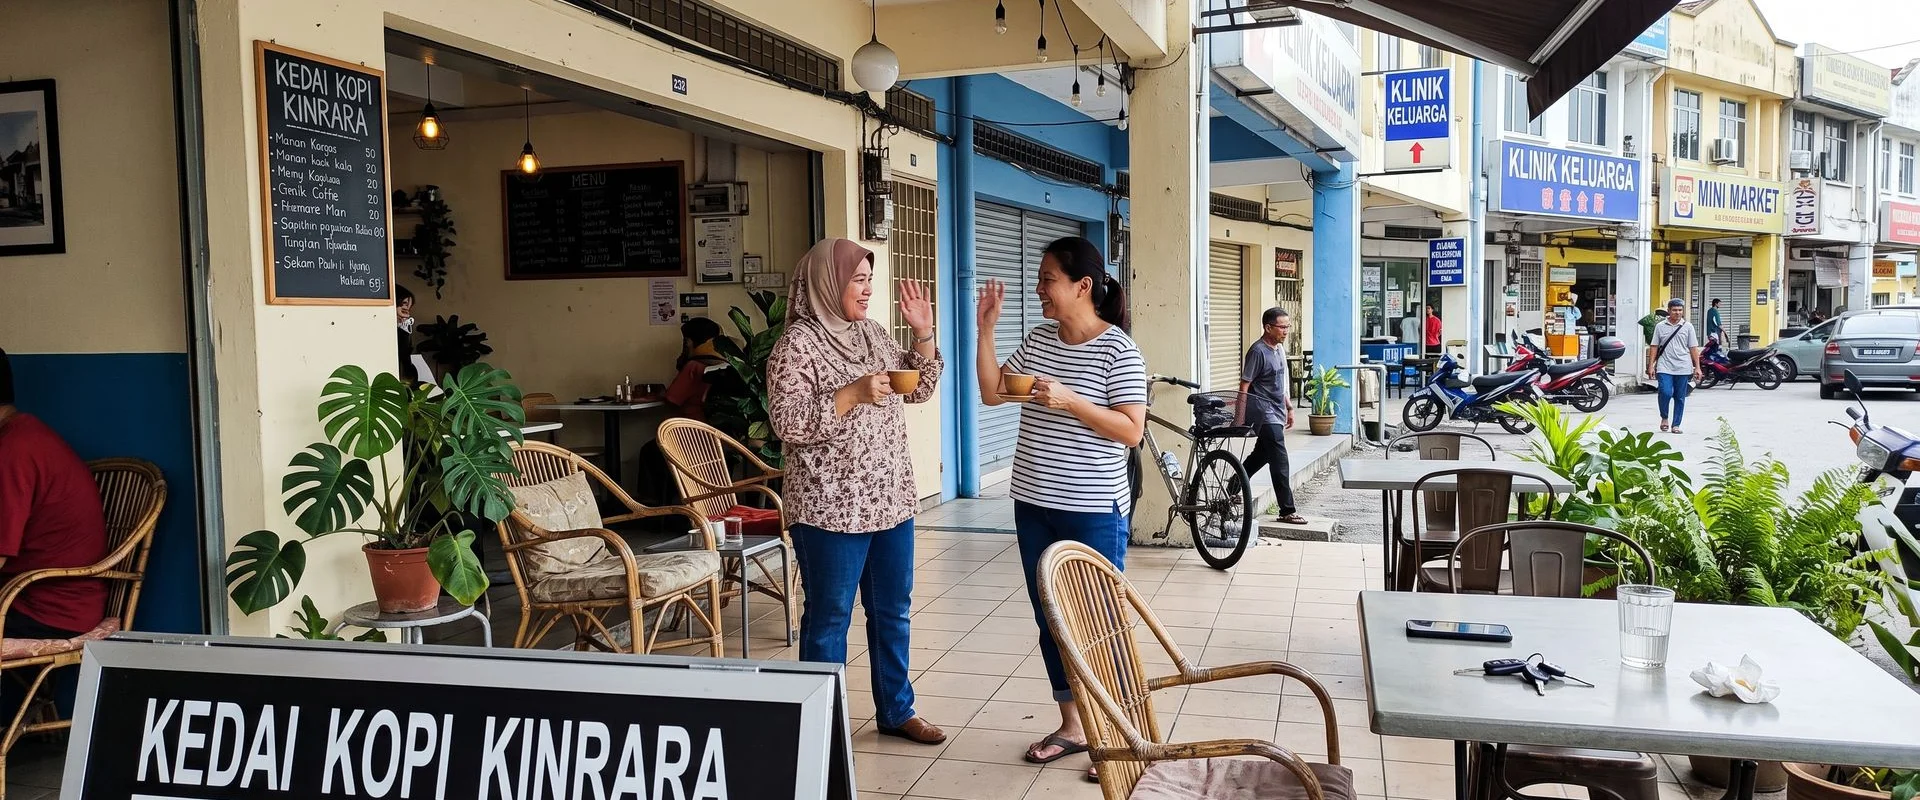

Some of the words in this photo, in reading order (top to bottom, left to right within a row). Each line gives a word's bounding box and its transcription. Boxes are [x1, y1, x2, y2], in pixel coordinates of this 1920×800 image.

[275, 58, 328, 96] KEDAI
[336, 72, 372, 105] KOPI
[1391, 76, 1444, 103] KLINIK
[283, 91, 369, 136] KINRARA
[1387, 104, 1447, 126] KELUARGA
[275, 132, 306, 149] Manan
[365, 148, 376, 159] 50
[276, 149, 307, 164] Manan
[366, 163, 377, 174] 20
[1508, 147, 1559, 183] KLINIK
[1561, 154, 1635, 192] KELUARGA
[366, 178, 378, 190] 20
[571, 171, 607, 188] MENU
[367, 194, 379, 205] 20
[1698, 179, 1726, 209] MINI
[1730, 184, 1780, 214] MARKET
[325, 204, 347, 218] Man
[368, 209, 380, 221] 20
[283, 255, 315, 269] Sekam
[136, 697, 300, 791] KEDAI
[321, 707, 454, 800] KOPI
[477, 715, 729, 800] KINRARA
